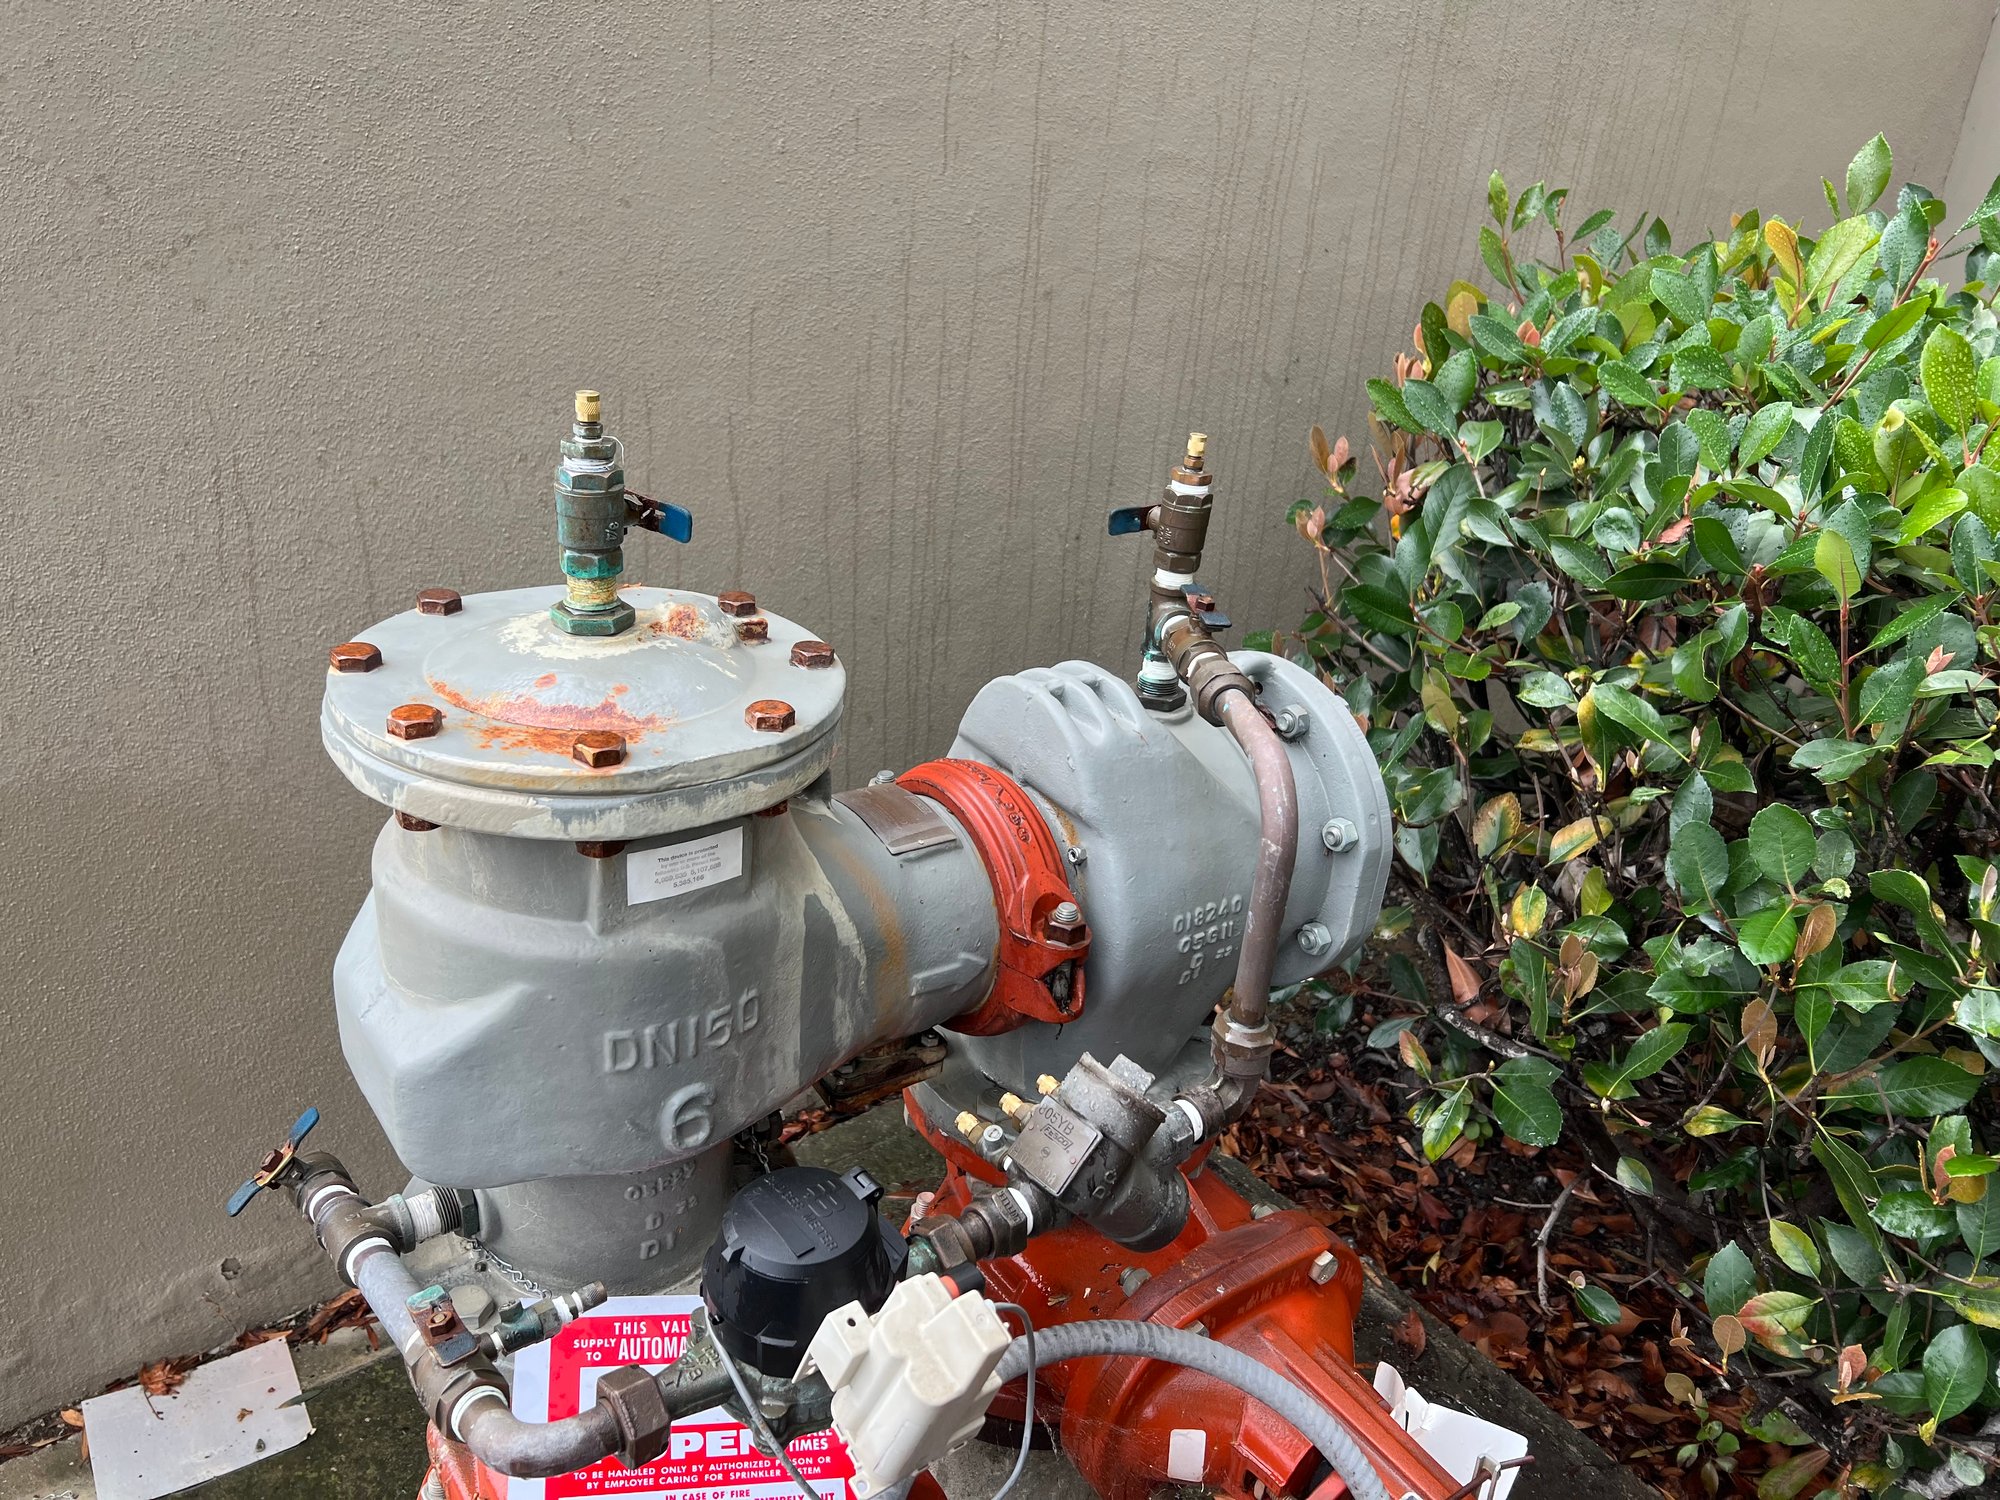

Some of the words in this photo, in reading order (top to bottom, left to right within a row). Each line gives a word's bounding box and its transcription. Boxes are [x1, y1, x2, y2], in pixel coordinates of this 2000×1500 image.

[603, 987, 761, 1073] DN150
[660, 1081, 716, 1152] 6
[1038, 1103, 1075, 1136] 805YB
[614, 1321, 647, 1335] THIS
[661, 1320, 692, 1334] VAL
[573, 1338, 616, 1348] SUPPLY
[586, 1351, 602, 1361] TO
[788, 1437, 829, 1452] TIMES
[573, 1472, 587, 1480] TO
[592, 1471, 604, 1479] BE
[608, 1467, 656, 1478] HANDLED
[661, 1465, 687, 1474] ONLY
[691, 1464, 704, 1472] BY
[709, 1460, 771, 1471] AUTHORIZED
[775, 1456, 813, 1467] PSON
[817, 1456, 831, 1464] OR
[586, 1481, 599, 1490] BY
[604, 1478, 655, 1489] EMPLOYEE
[659, 1474, 698, 1485] CARING
[704, 1473, 723, 1481] FOR
[729, 1469, 781, 1480] SPRINKLER
[682, 1492, 706, 1500] CASE
[712, 1491, 725, 1499] OF
[730, 1489, 751, 1498] FIRE
